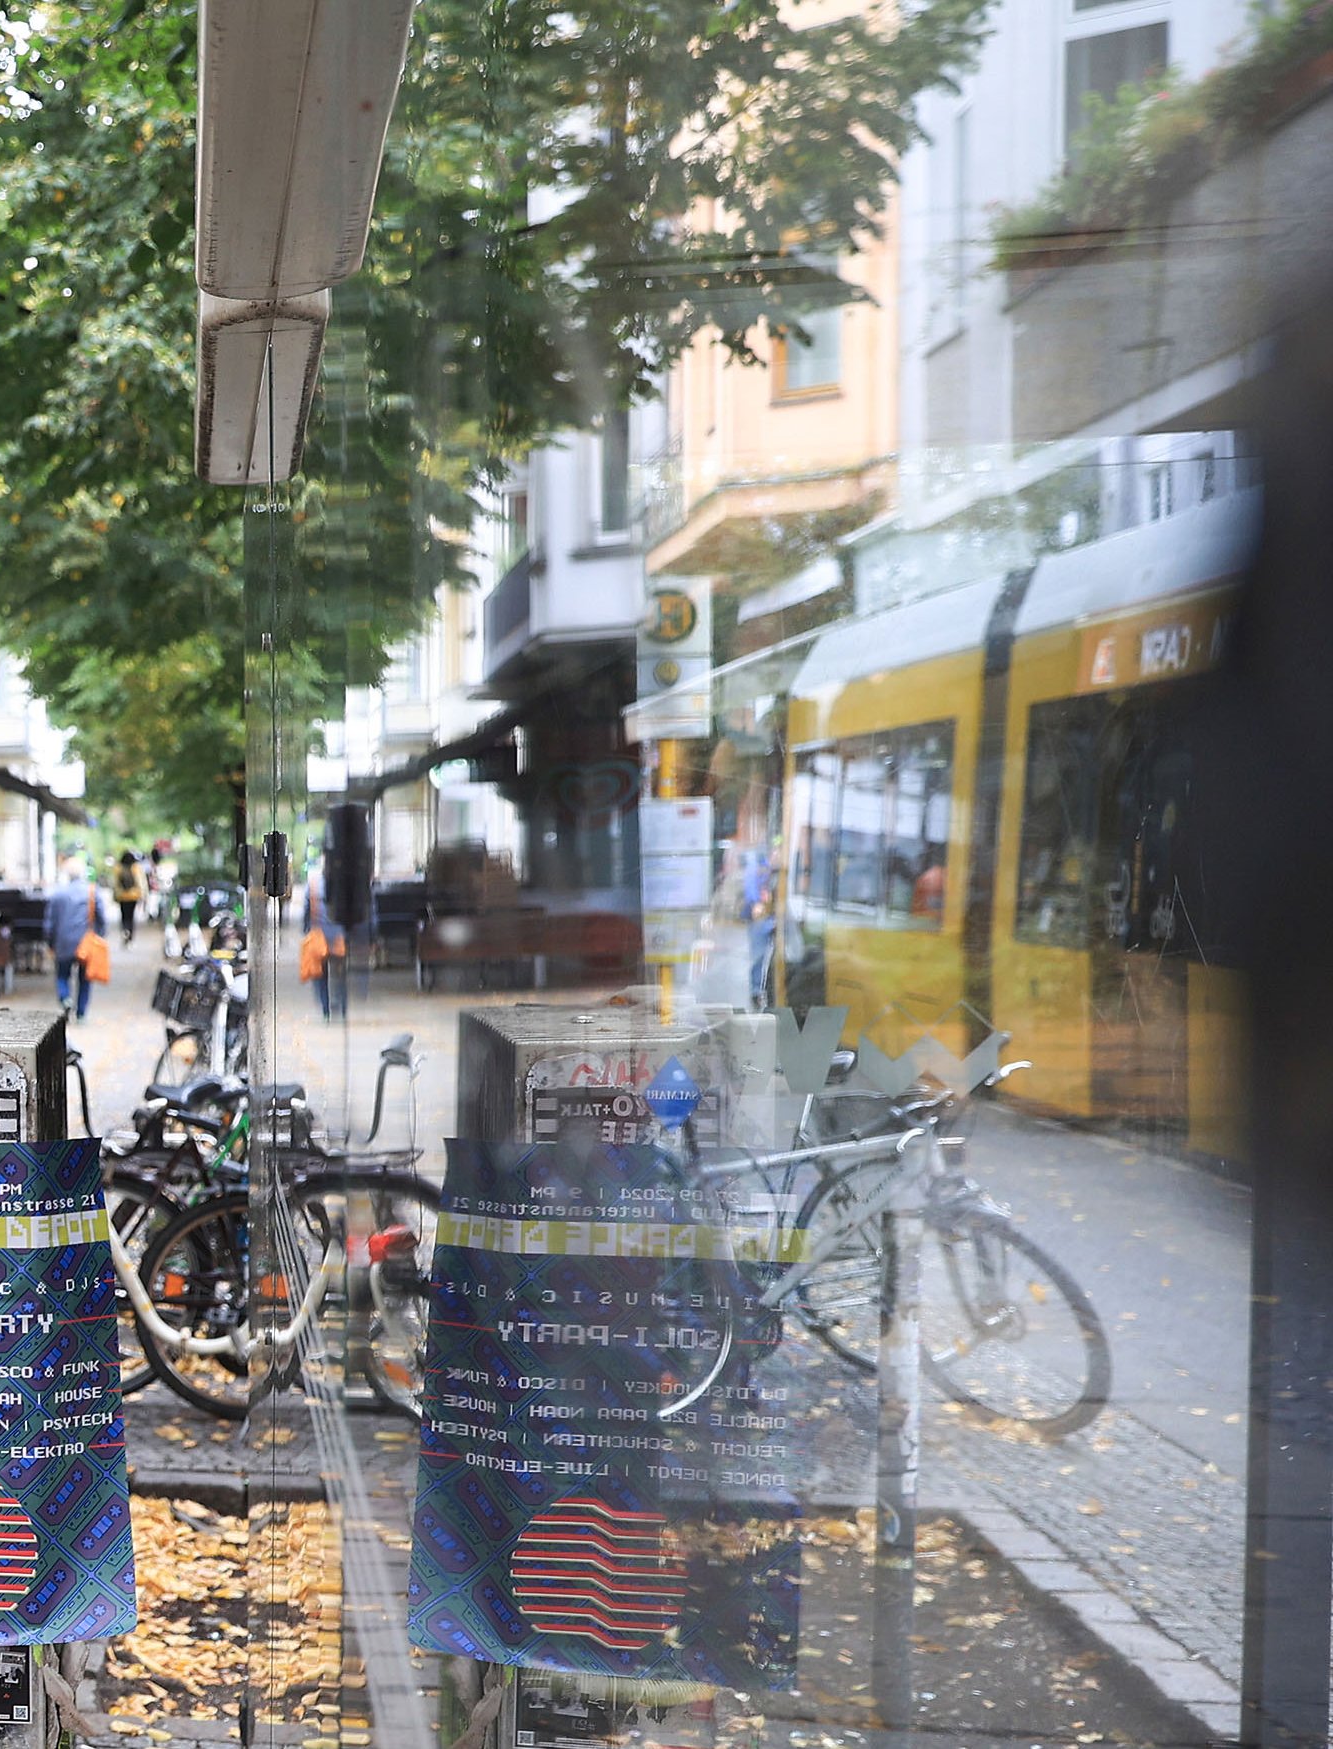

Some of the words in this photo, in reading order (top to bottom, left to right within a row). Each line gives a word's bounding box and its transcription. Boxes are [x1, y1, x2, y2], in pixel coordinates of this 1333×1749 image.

[0, 1183, 22, 1196] PM
[81, 1195, 96, 1207] 21
[6, 1210, 98, 1249] DEPOT
[63, 1361, 100, 1376] FUNK
[55, 1387, 102, 1404] HOUSE
[43, 1412, 113, 1431] PSYTECH
